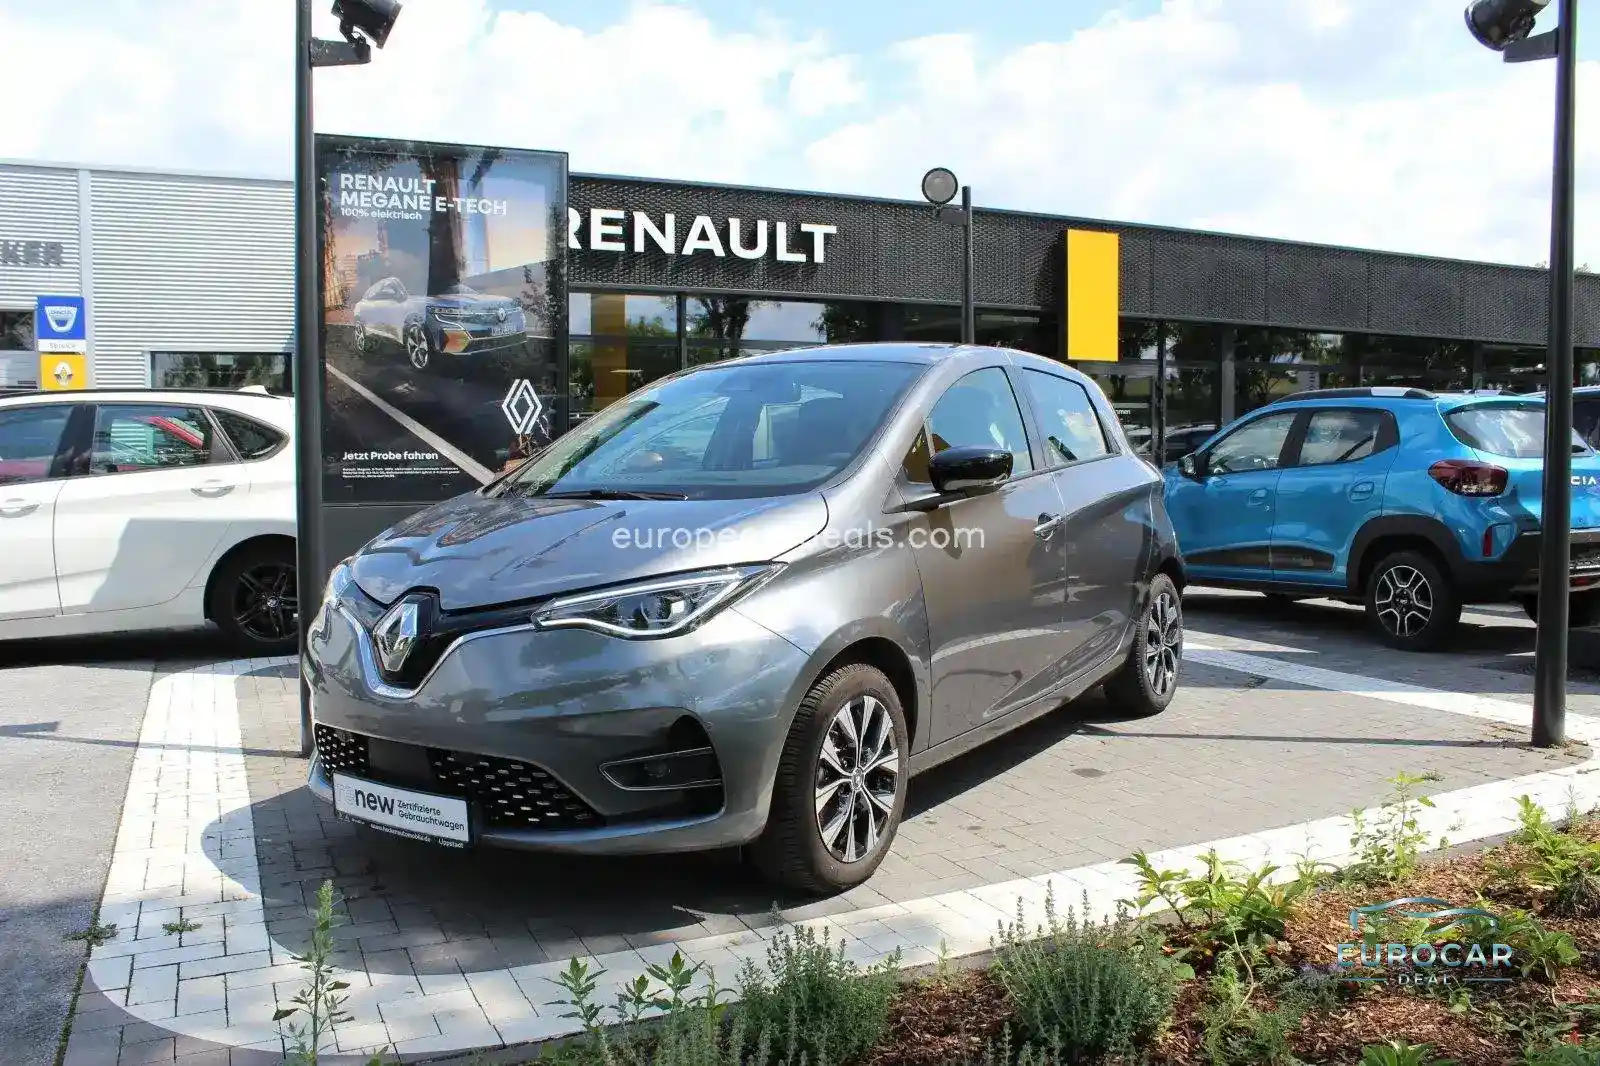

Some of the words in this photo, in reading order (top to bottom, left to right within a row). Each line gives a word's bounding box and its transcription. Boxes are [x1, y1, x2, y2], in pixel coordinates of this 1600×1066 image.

[340, 173, 437, 194] RENAULT
[340, 190, 431, 212] MEGANE
[435, 196, 507, 216] E-TECH
[340, 208, 370, 217] 100%
[370, 208, 423, 221] elektrisch
[342, 451, 369, 461] Jetzt
[370, 451, 402, 461] Probe
[403, 450, 439, 461] fahren
[397, 800, 441, 816] Zertifizierte
[398, 809, 465, 832] Gebrauchtwagen
